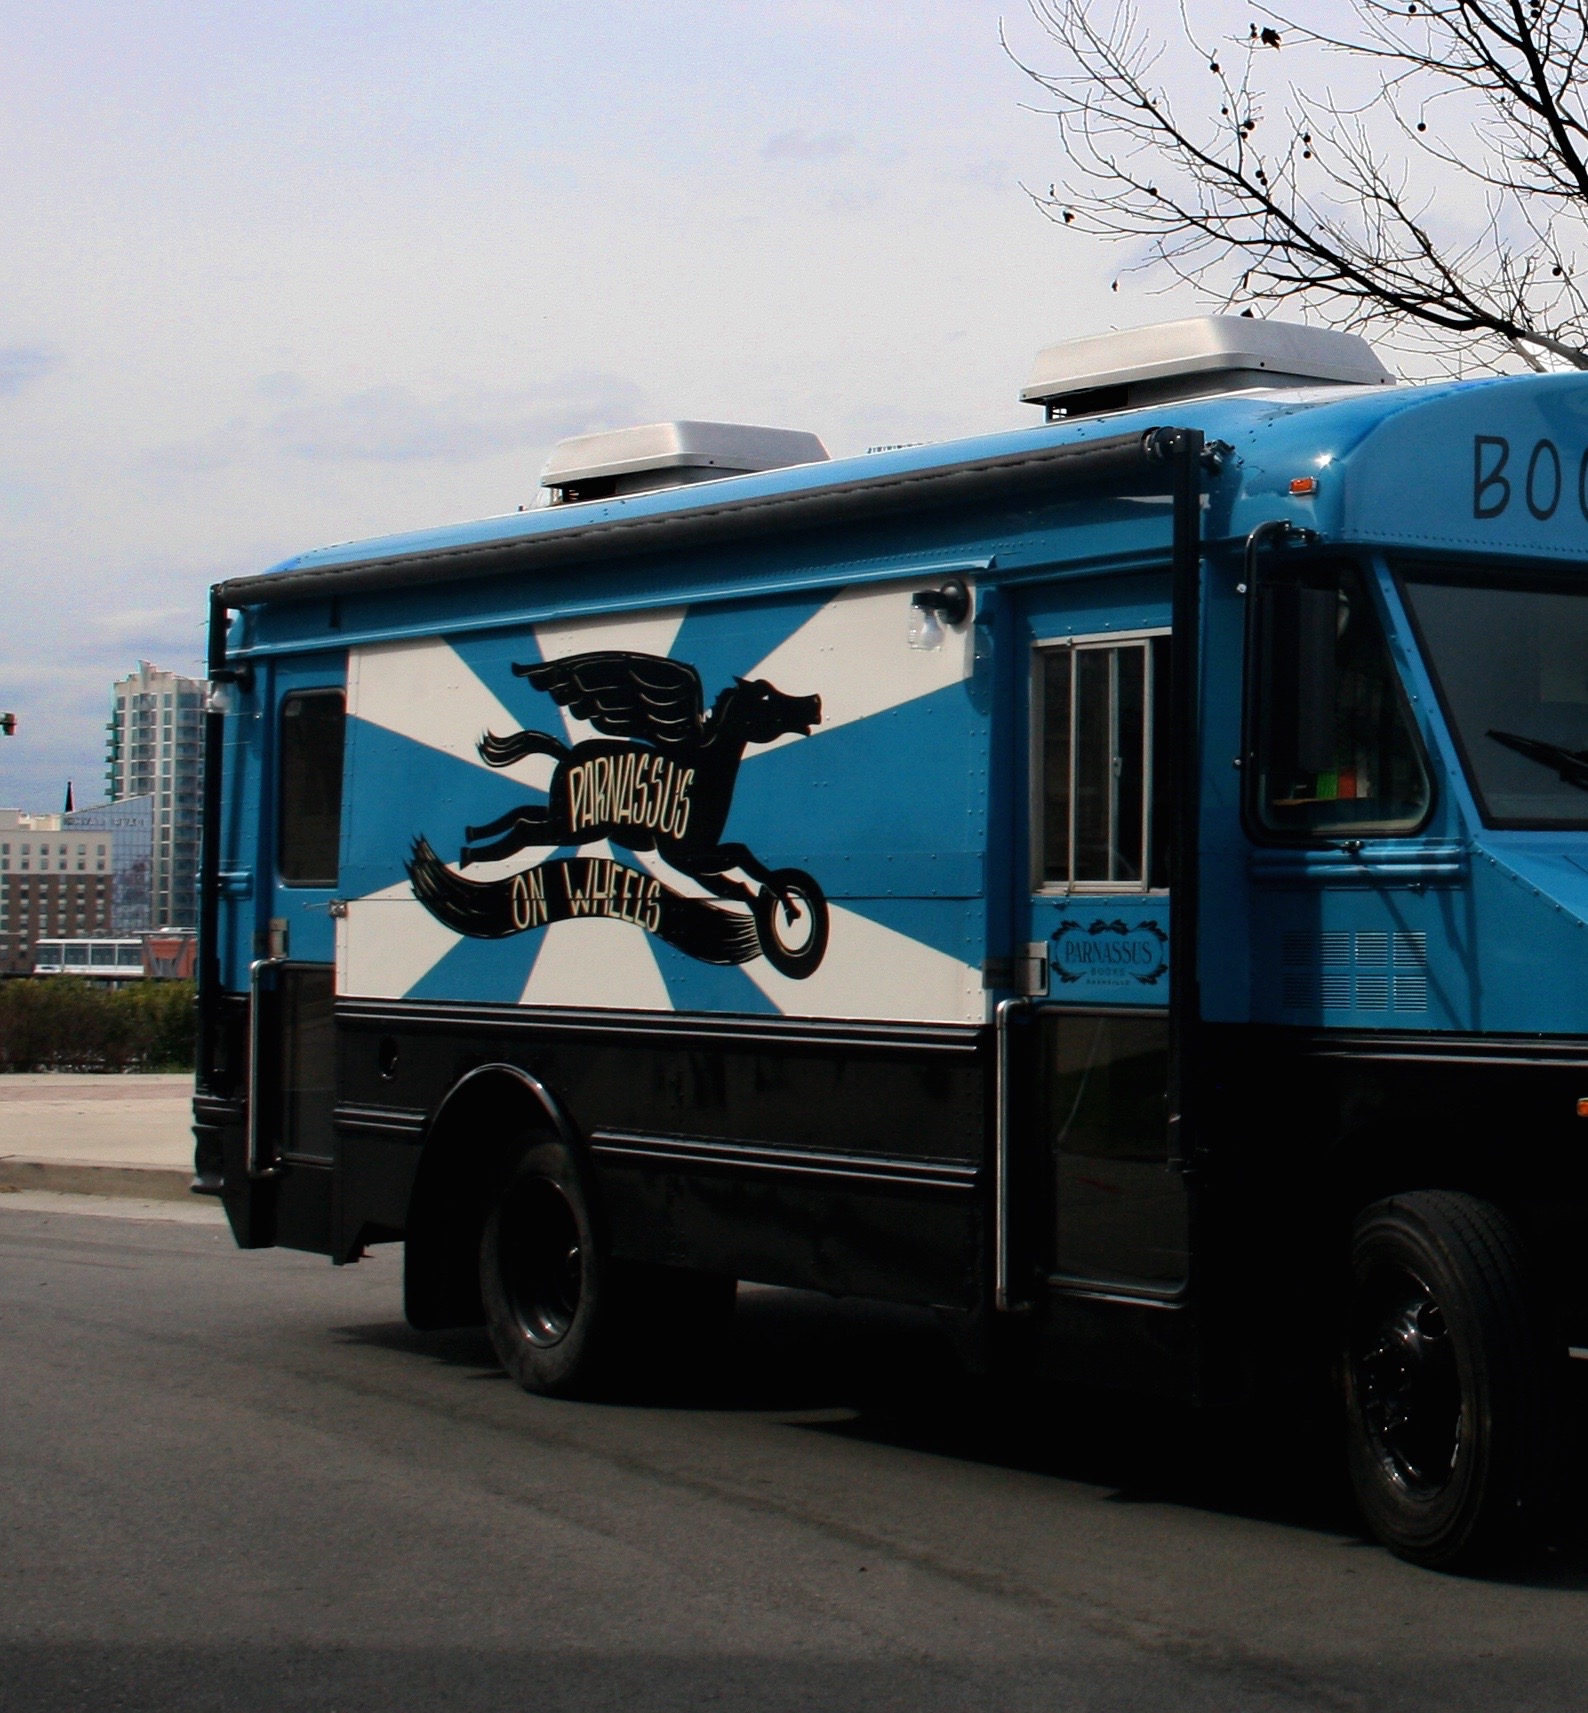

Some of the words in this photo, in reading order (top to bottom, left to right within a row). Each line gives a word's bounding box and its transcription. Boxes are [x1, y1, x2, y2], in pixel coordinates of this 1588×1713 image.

[568, 752, 695, 840] PARNASSUS
[512, 867, 547, 930] ON
[562, 858, 662, 933] WHEELS
[1066, 941, 1153, 964] PARNASSUS
